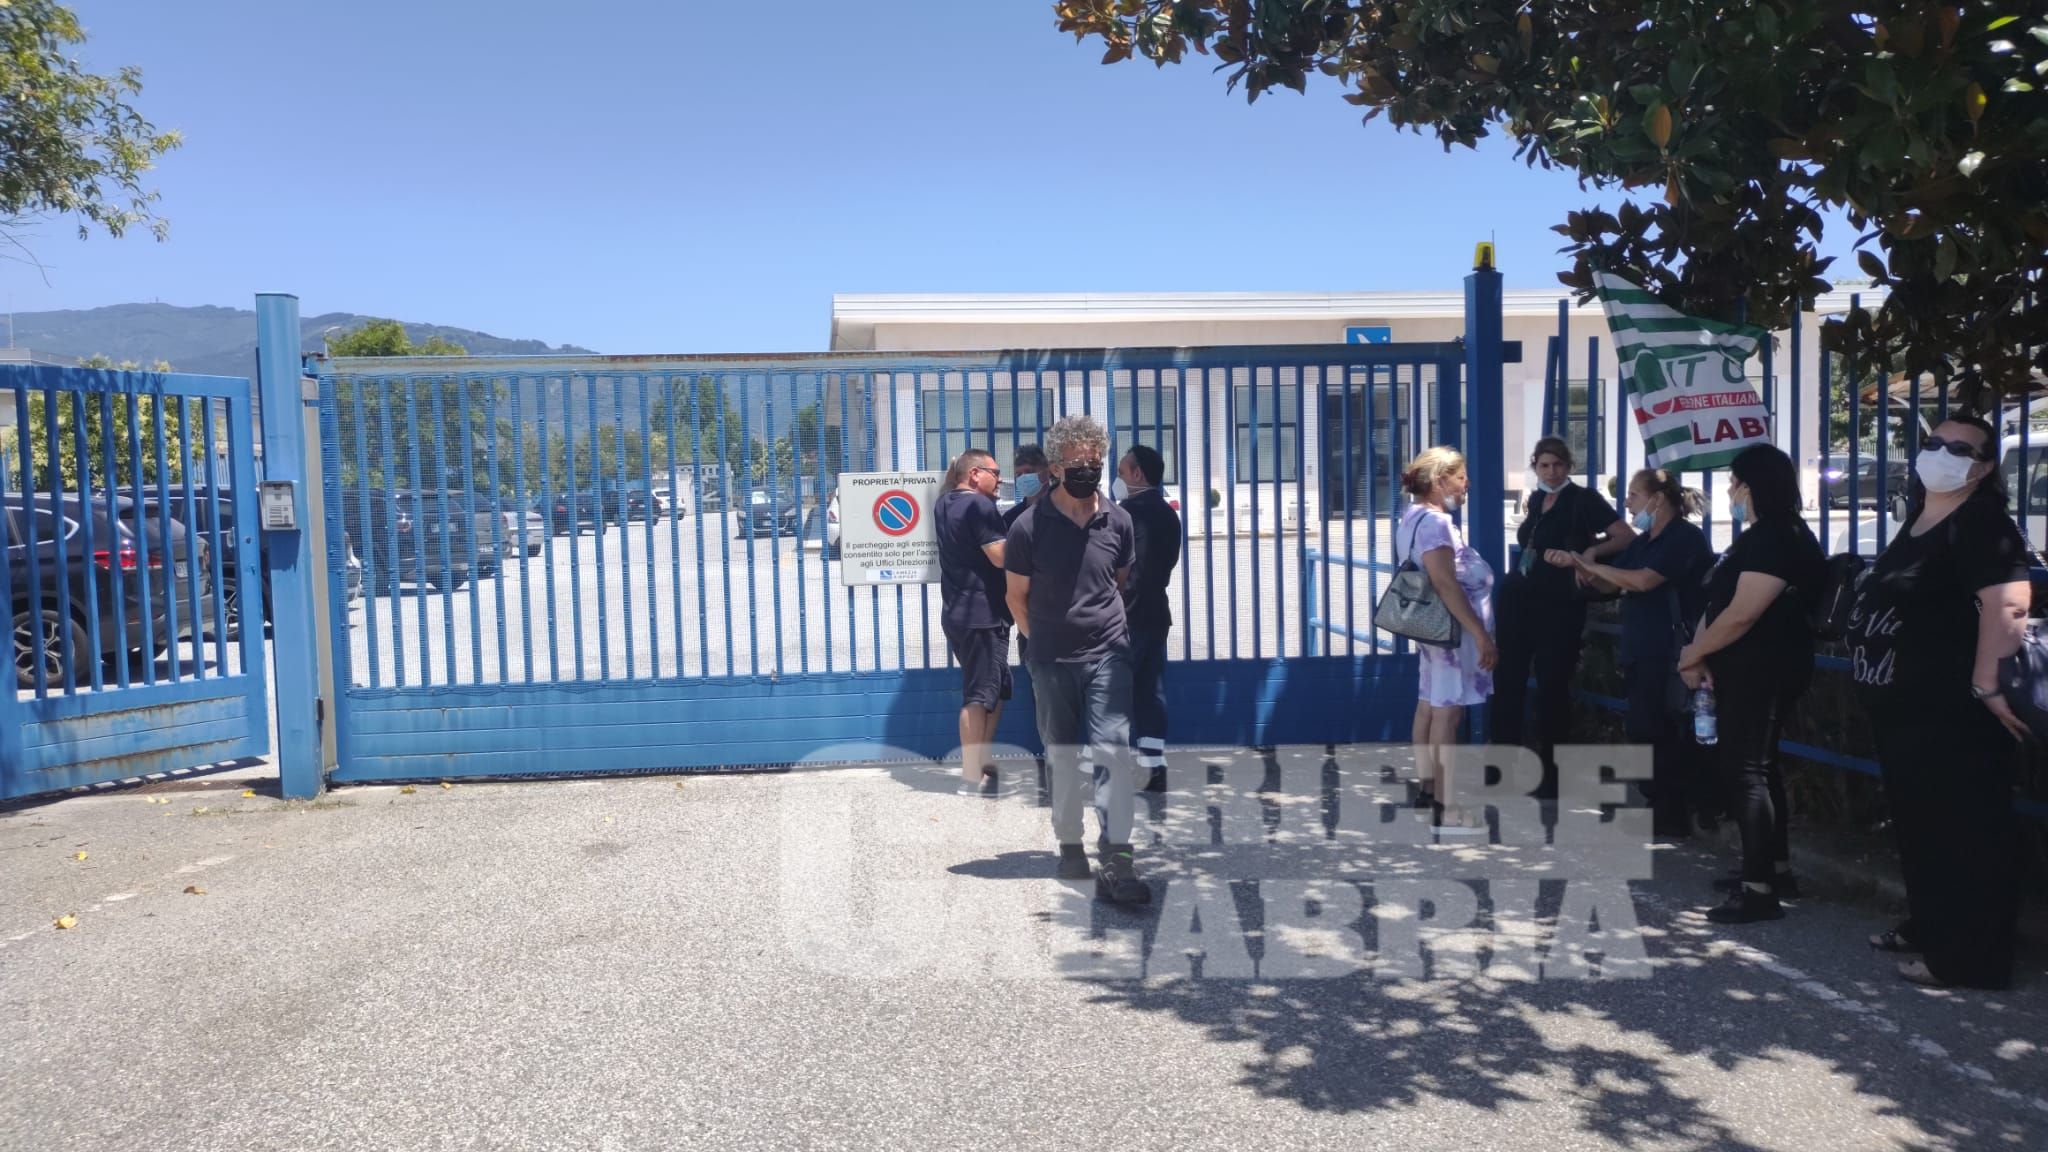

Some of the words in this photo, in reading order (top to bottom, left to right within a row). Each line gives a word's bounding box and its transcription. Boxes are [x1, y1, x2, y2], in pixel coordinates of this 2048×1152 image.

[852, 478, 901, 486] PROPRIETA'
[903, 477, 937, 485] PRIVATA
[852, 541, 894, 550] parcheggio
[896, 541, 910, 549] agli
[844, 551, 881, 559] consentito
[860, 560, 873, 569] agli
[876, 559, 895, 567] Uffici
[896, 558, 936, 566] Direzionali
